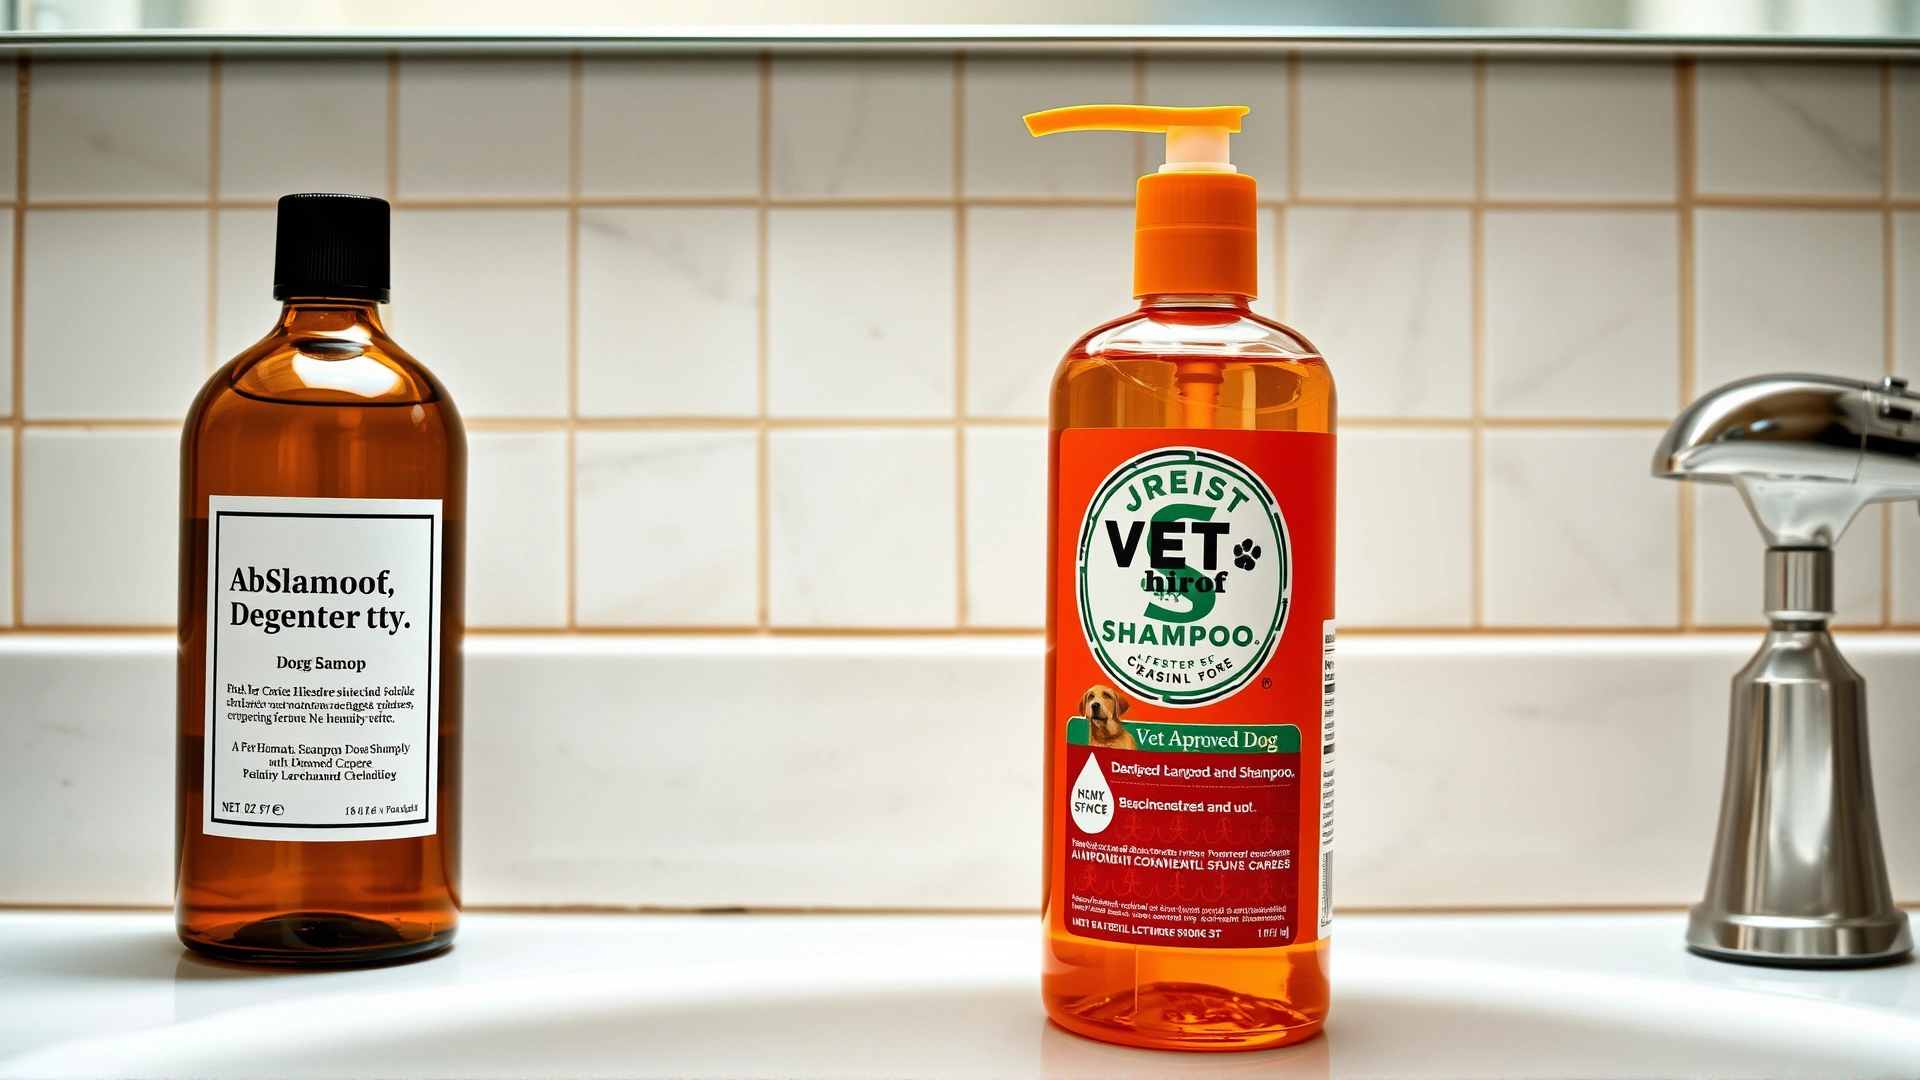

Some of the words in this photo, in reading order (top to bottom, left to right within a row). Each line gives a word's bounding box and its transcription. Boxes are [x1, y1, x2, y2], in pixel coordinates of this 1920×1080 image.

[1126, 470, 1250, 513] JREIST
[1105, 520, 1230, 571] VET
[229, 566, 395, 599] AbSlamoof,
[1144, 570, 1229, 594] hirof
[230, 601, 361, 635] Degenter
[367, 606, 411, 636] tty.
[1102, 619, 1254, 648] SHAMPOO
[315, 656, 367, 674] Samop
[232, 741, 240, 752] A
[1136, 727, 1165, 748] Vet
[1243, 731, 1279, 753] Dog
[1213, 766, 1237, 778] and
[222, 801, 241, 813] NET
[1207, 801, 1232, 813] and
